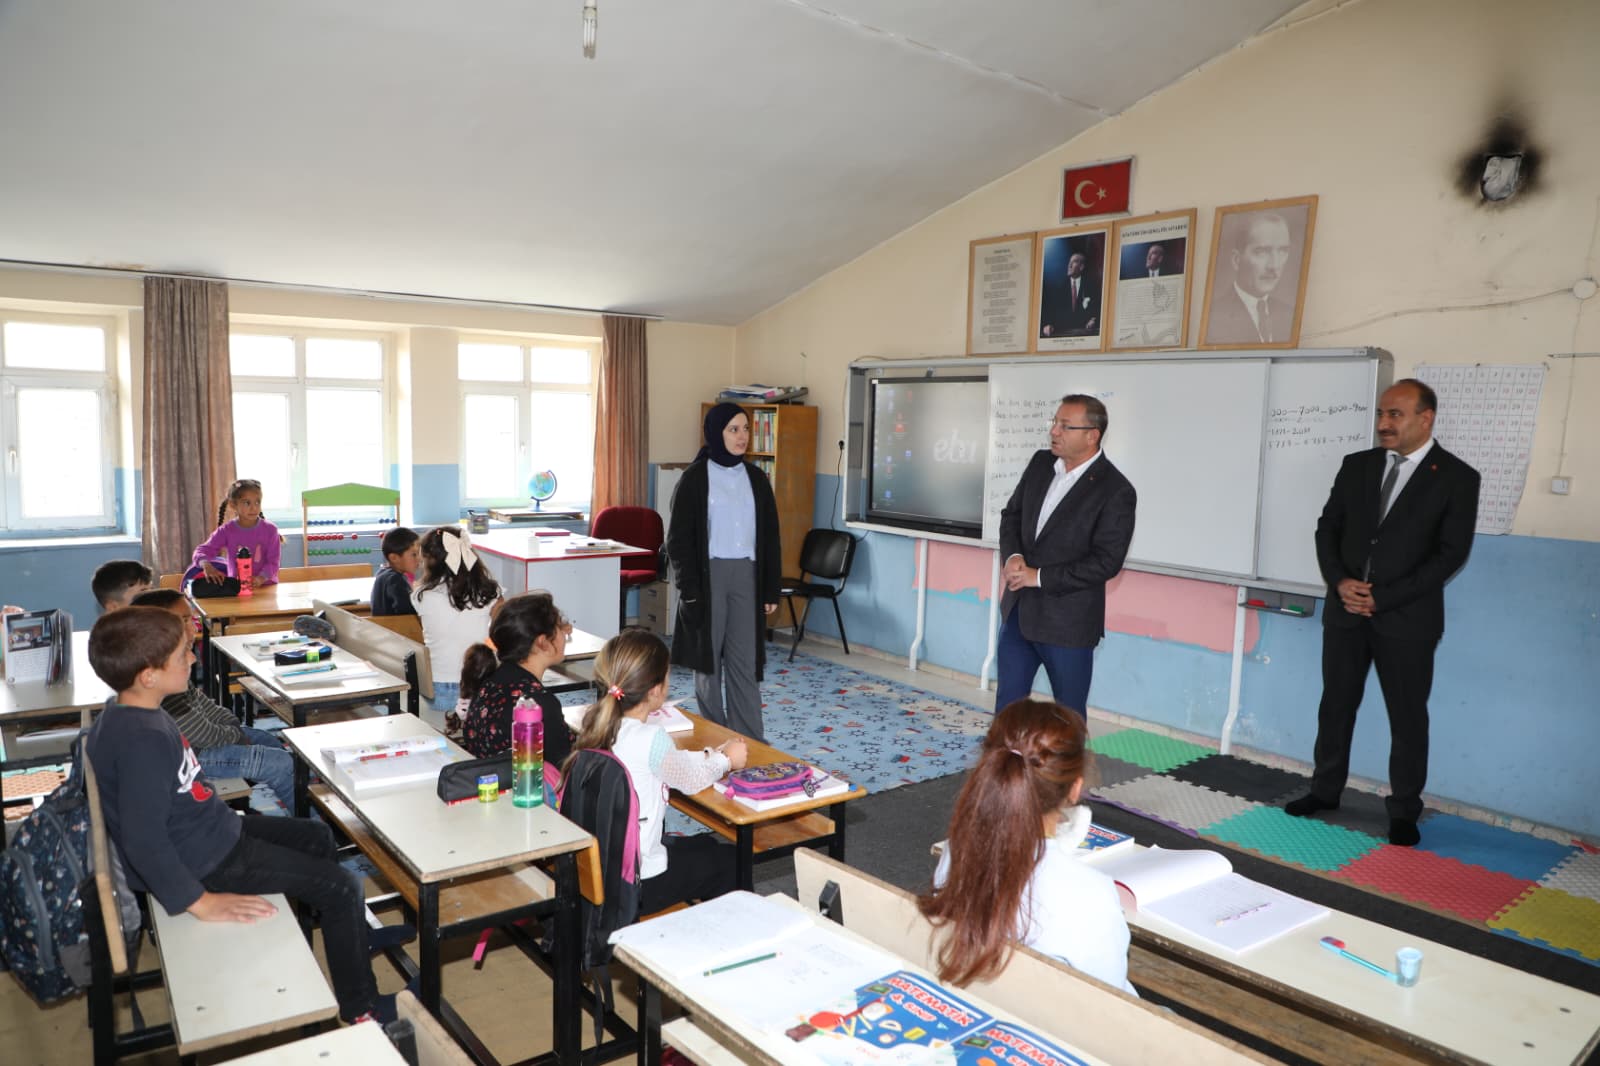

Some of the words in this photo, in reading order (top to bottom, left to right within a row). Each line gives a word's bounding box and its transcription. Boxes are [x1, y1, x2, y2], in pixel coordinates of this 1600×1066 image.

[888, 977, 974, 1027] MATEMATİK
[890, 992, 905, 1005] 4.
[903, 1001, 938, 1022] SINIF
[990, 1045, 1005, 1059] 4.
